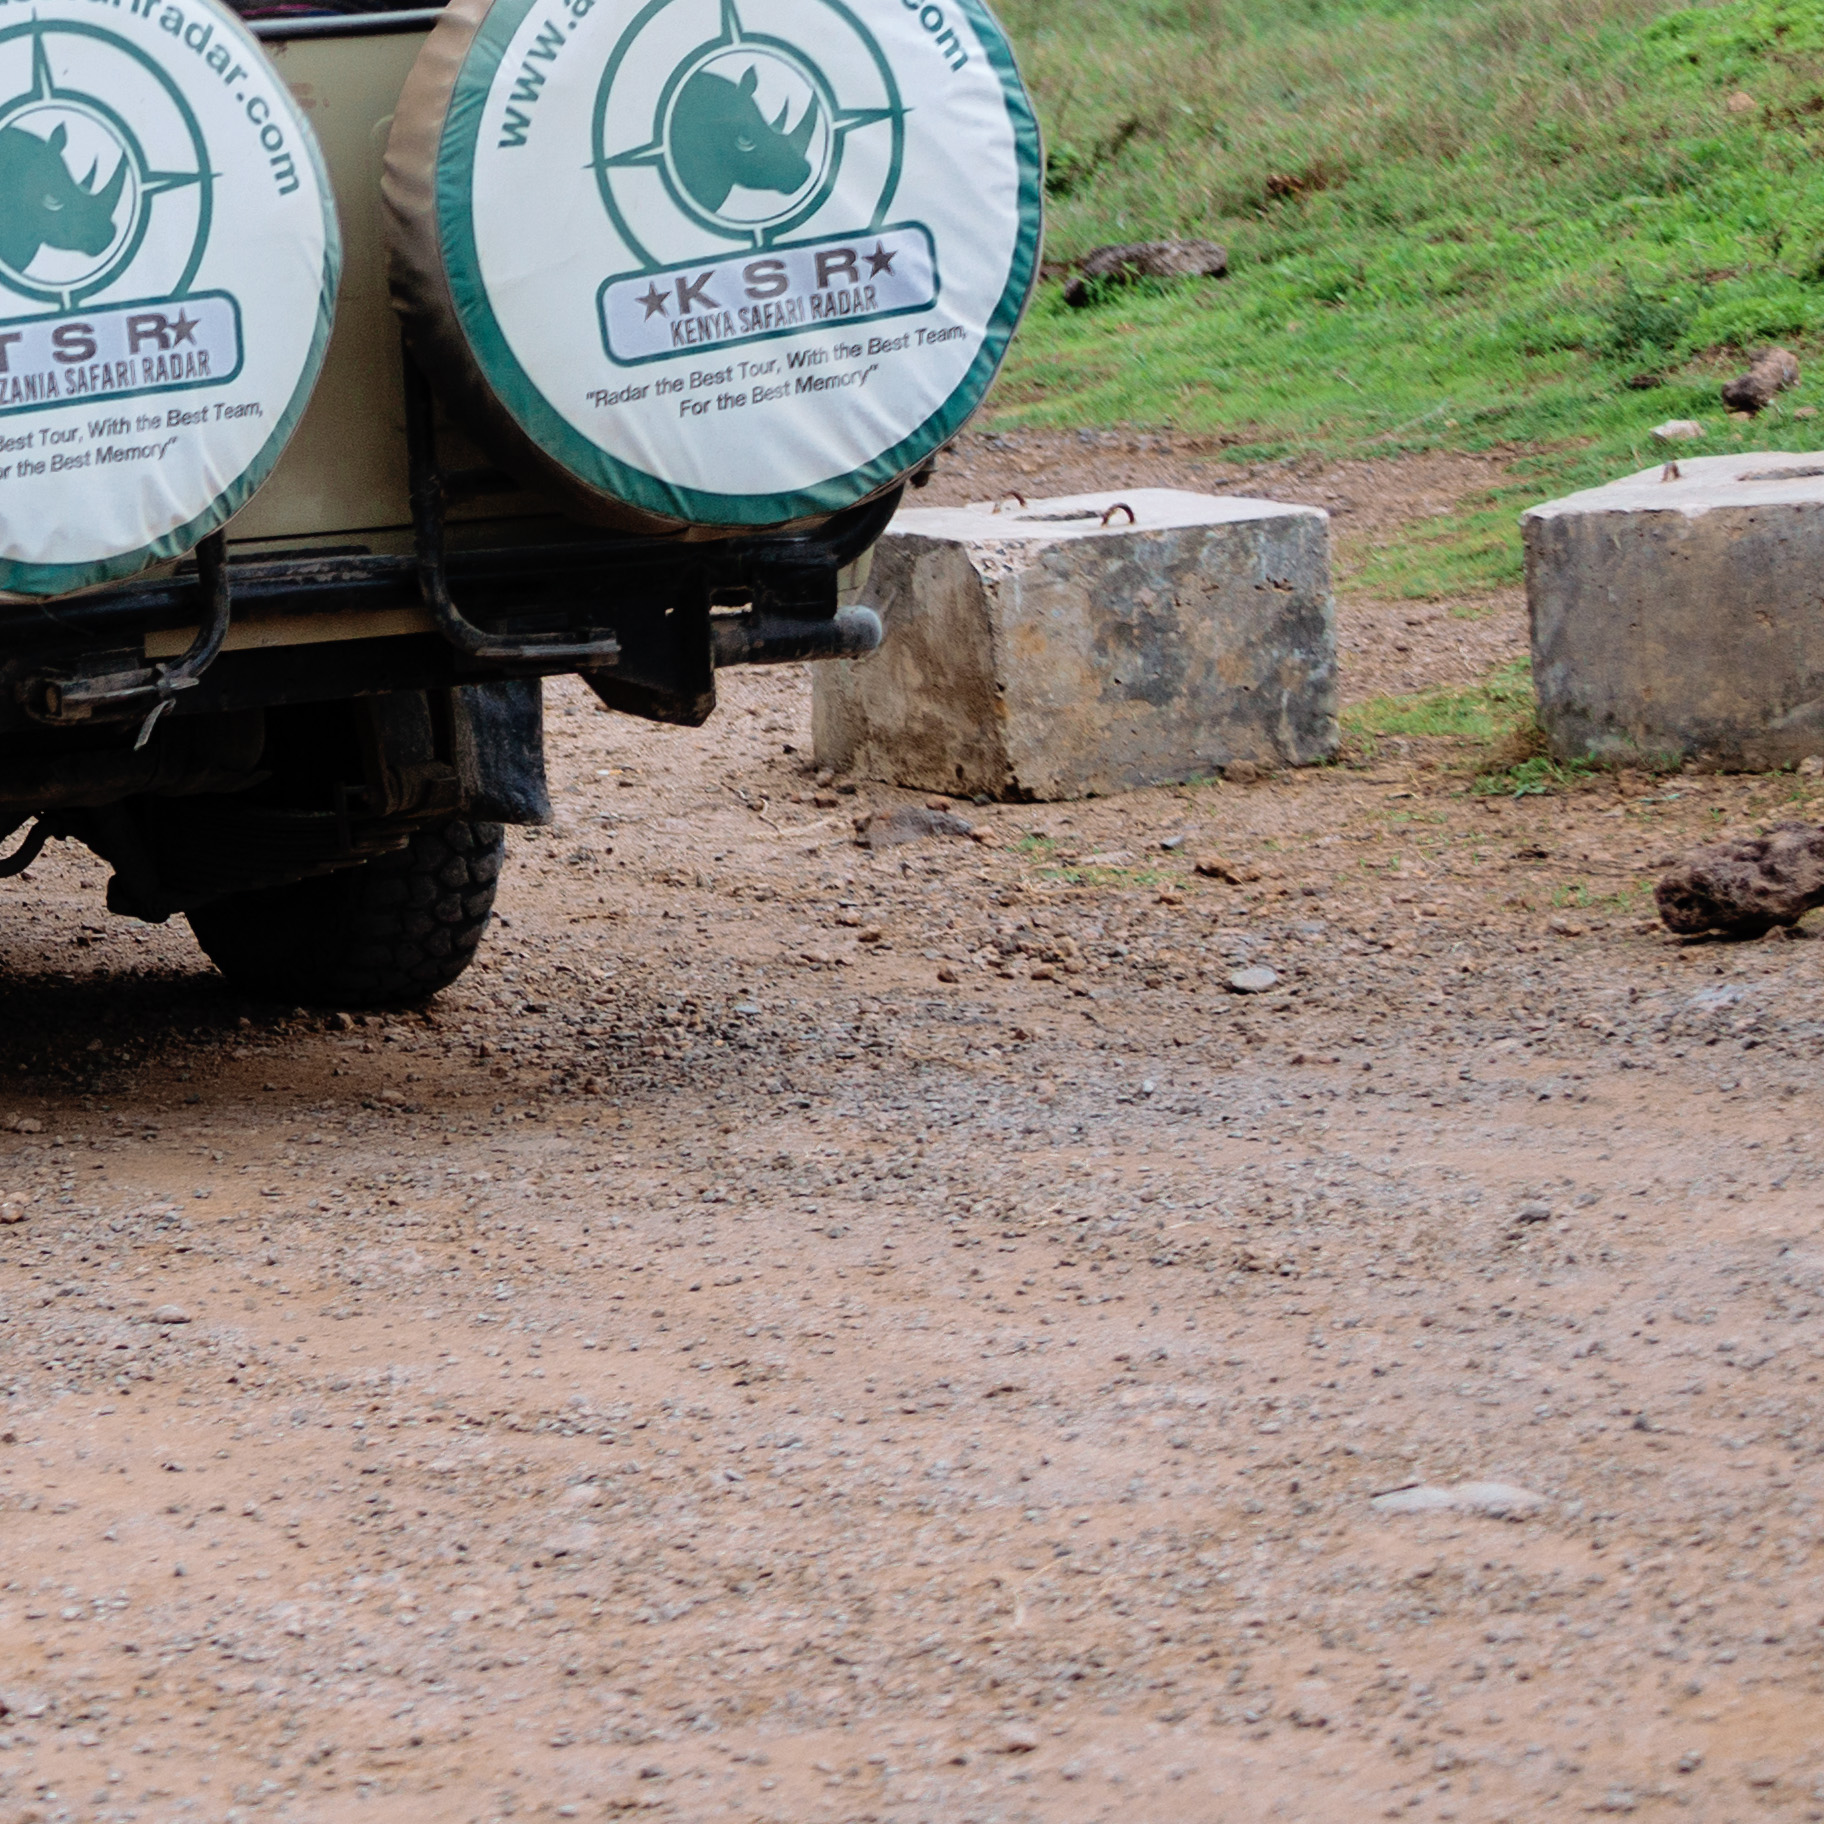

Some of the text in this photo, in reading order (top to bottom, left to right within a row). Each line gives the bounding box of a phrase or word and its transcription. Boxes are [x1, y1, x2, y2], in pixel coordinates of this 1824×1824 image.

[670, 284, 879, 347] KENYA SAFARI RADAR
[64, 357, 137, 396] SAFARI
[141, 349, 212, 385] RADAR
[655, 377, 685, 397] the
[689, 367, 734, 390] Best
[737, 358, 782, 380] Tour,
[786, 346, 829, 370] With
[833, 342, 863, 361] the
[867, 332, 911, 356] Best
[914, 325, 968, 347] Team,
[38, 426, 84, 447] Tour,
[87, 416, 132, 440] With
[136, 413, 163, 434] the
[166, 405, 210, 429] Best
[213, 400, 264, 422] Team,
[679, 398, 712, 419] For
[716, 391, 748, 411] the
[751, 381, 791, 405] Best
[16, 458, 47, 478] the
[50, 450, 91, 474] Best
